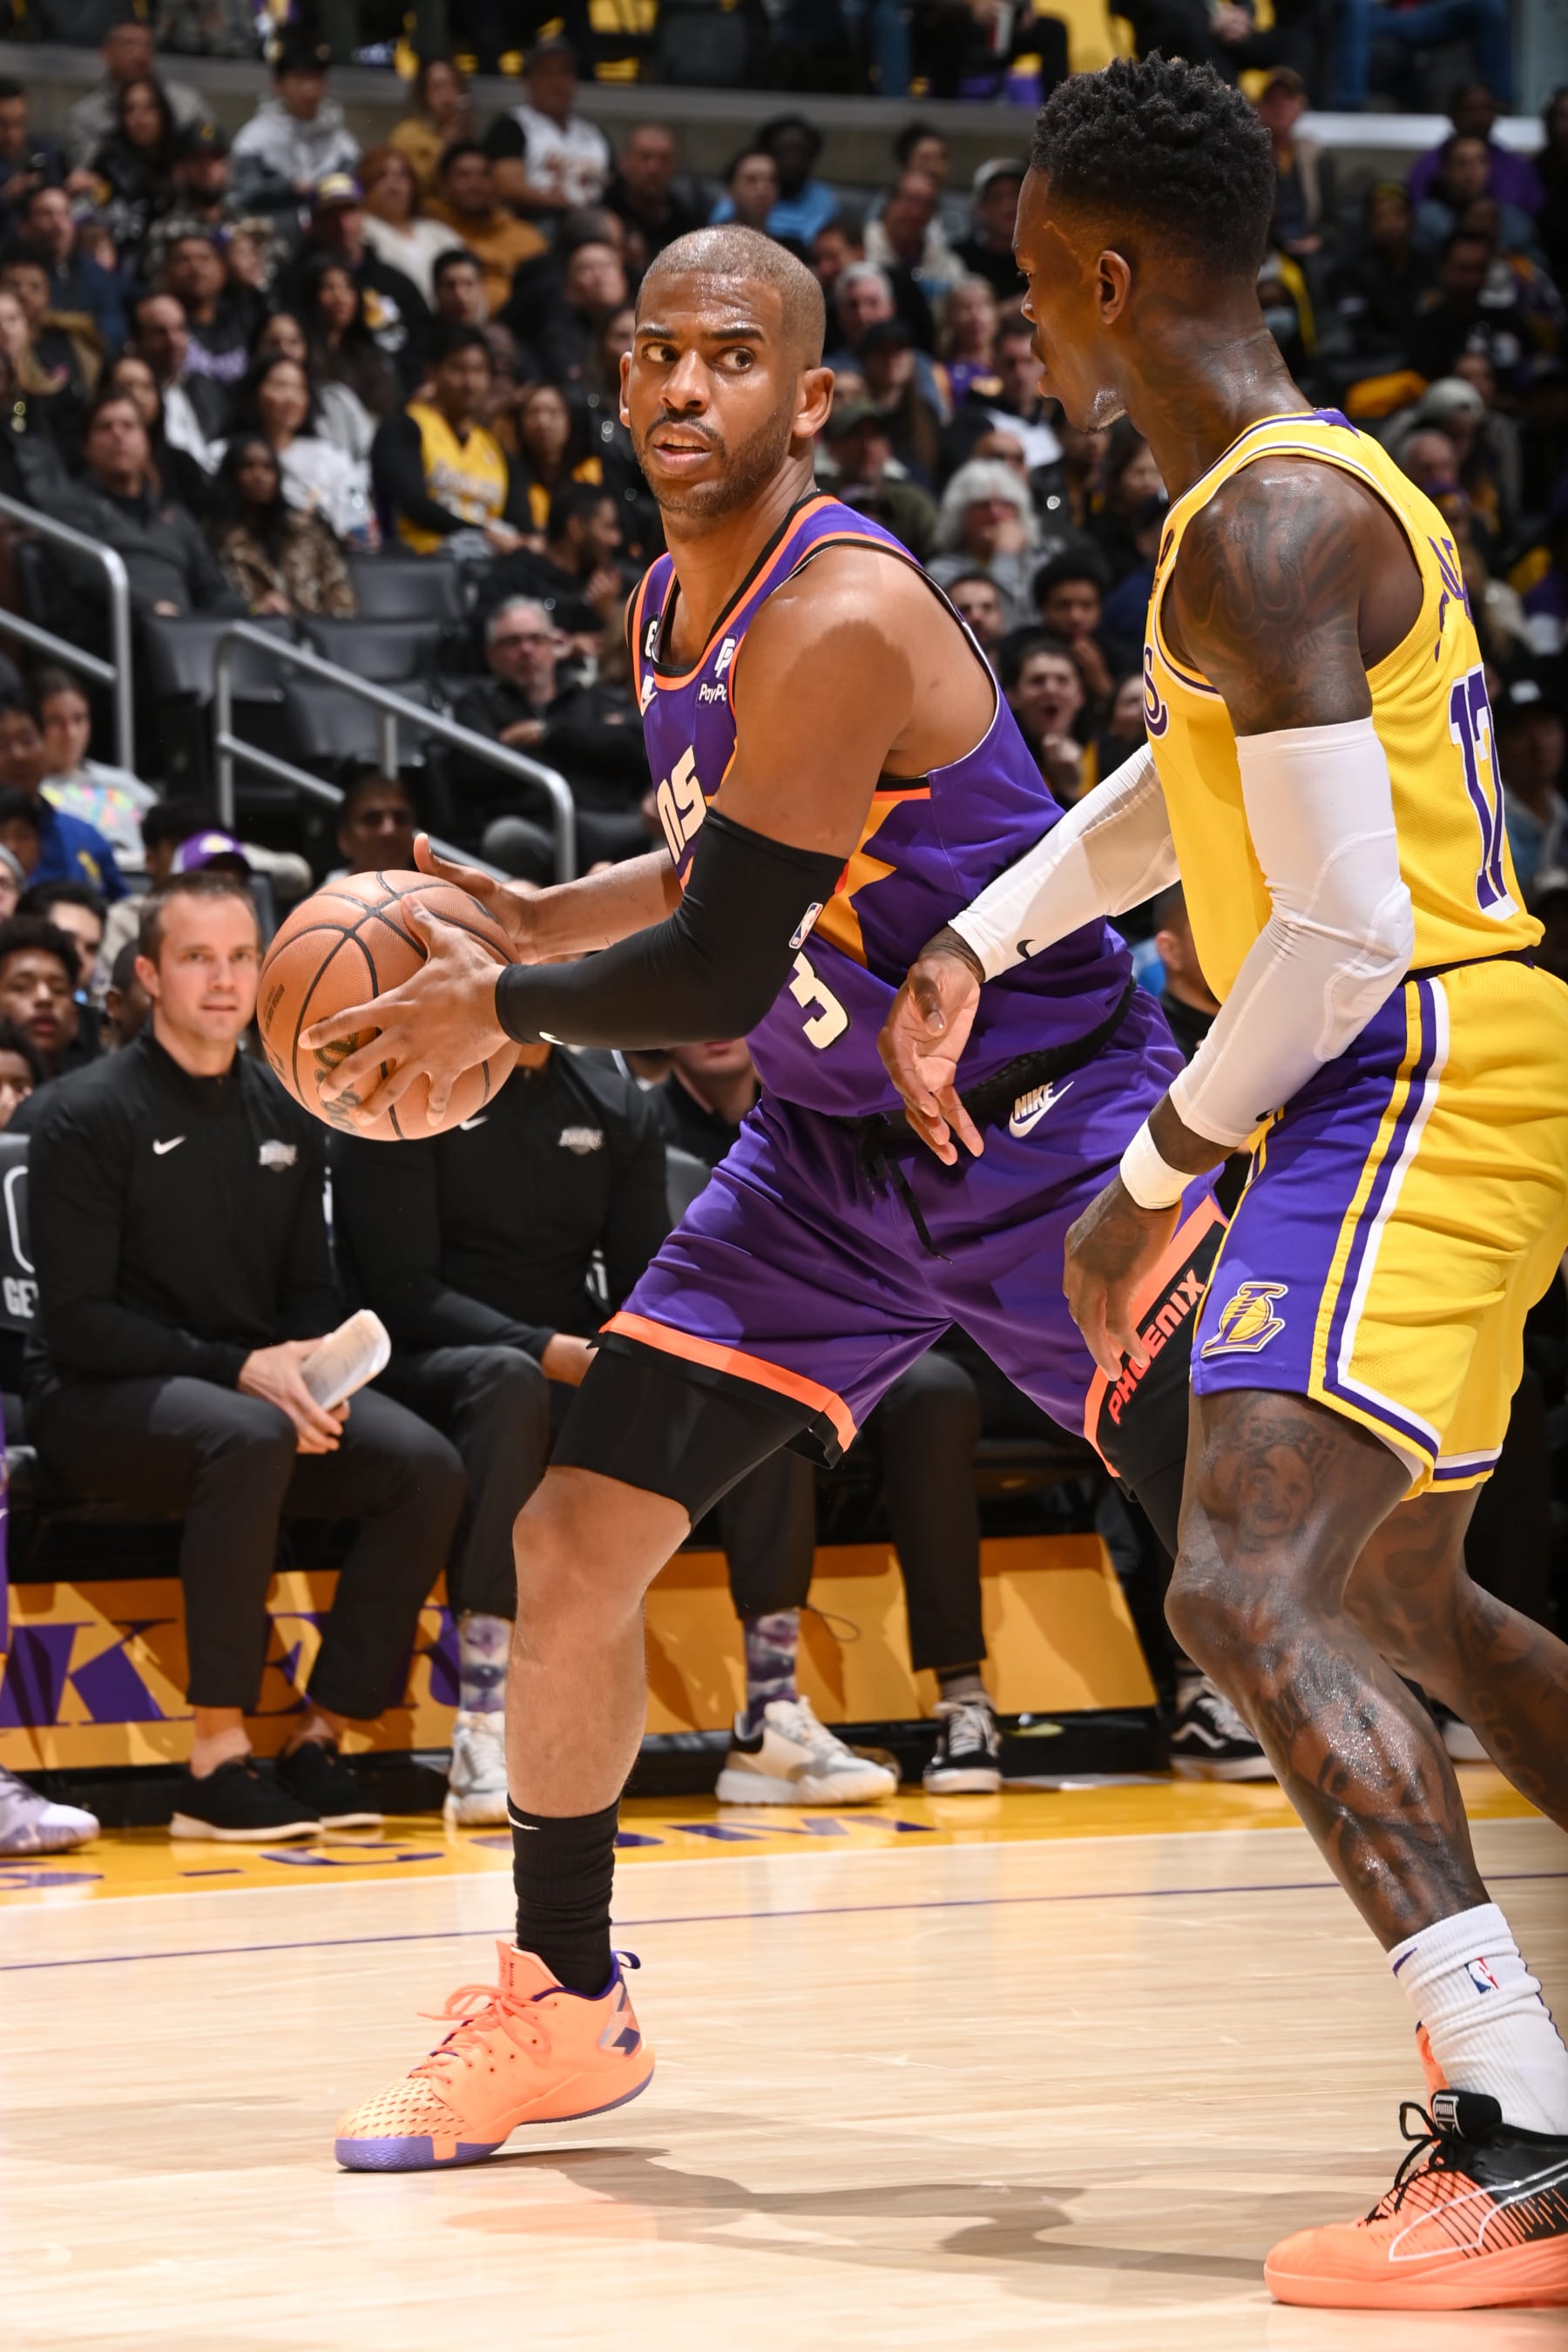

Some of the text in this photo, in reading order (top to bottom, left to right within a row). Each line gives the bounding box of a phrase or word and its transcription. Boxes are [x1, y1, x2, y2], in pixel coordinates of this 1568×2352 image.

[1449, 662, 1520, 922] 17
[788, 950, 848, 1050] 3
[1014, 1081, 1055, 1121] NIKE
[3, 1276, 39, 1319] GE
[1435, 2103, 1454, 2116] PUMA
